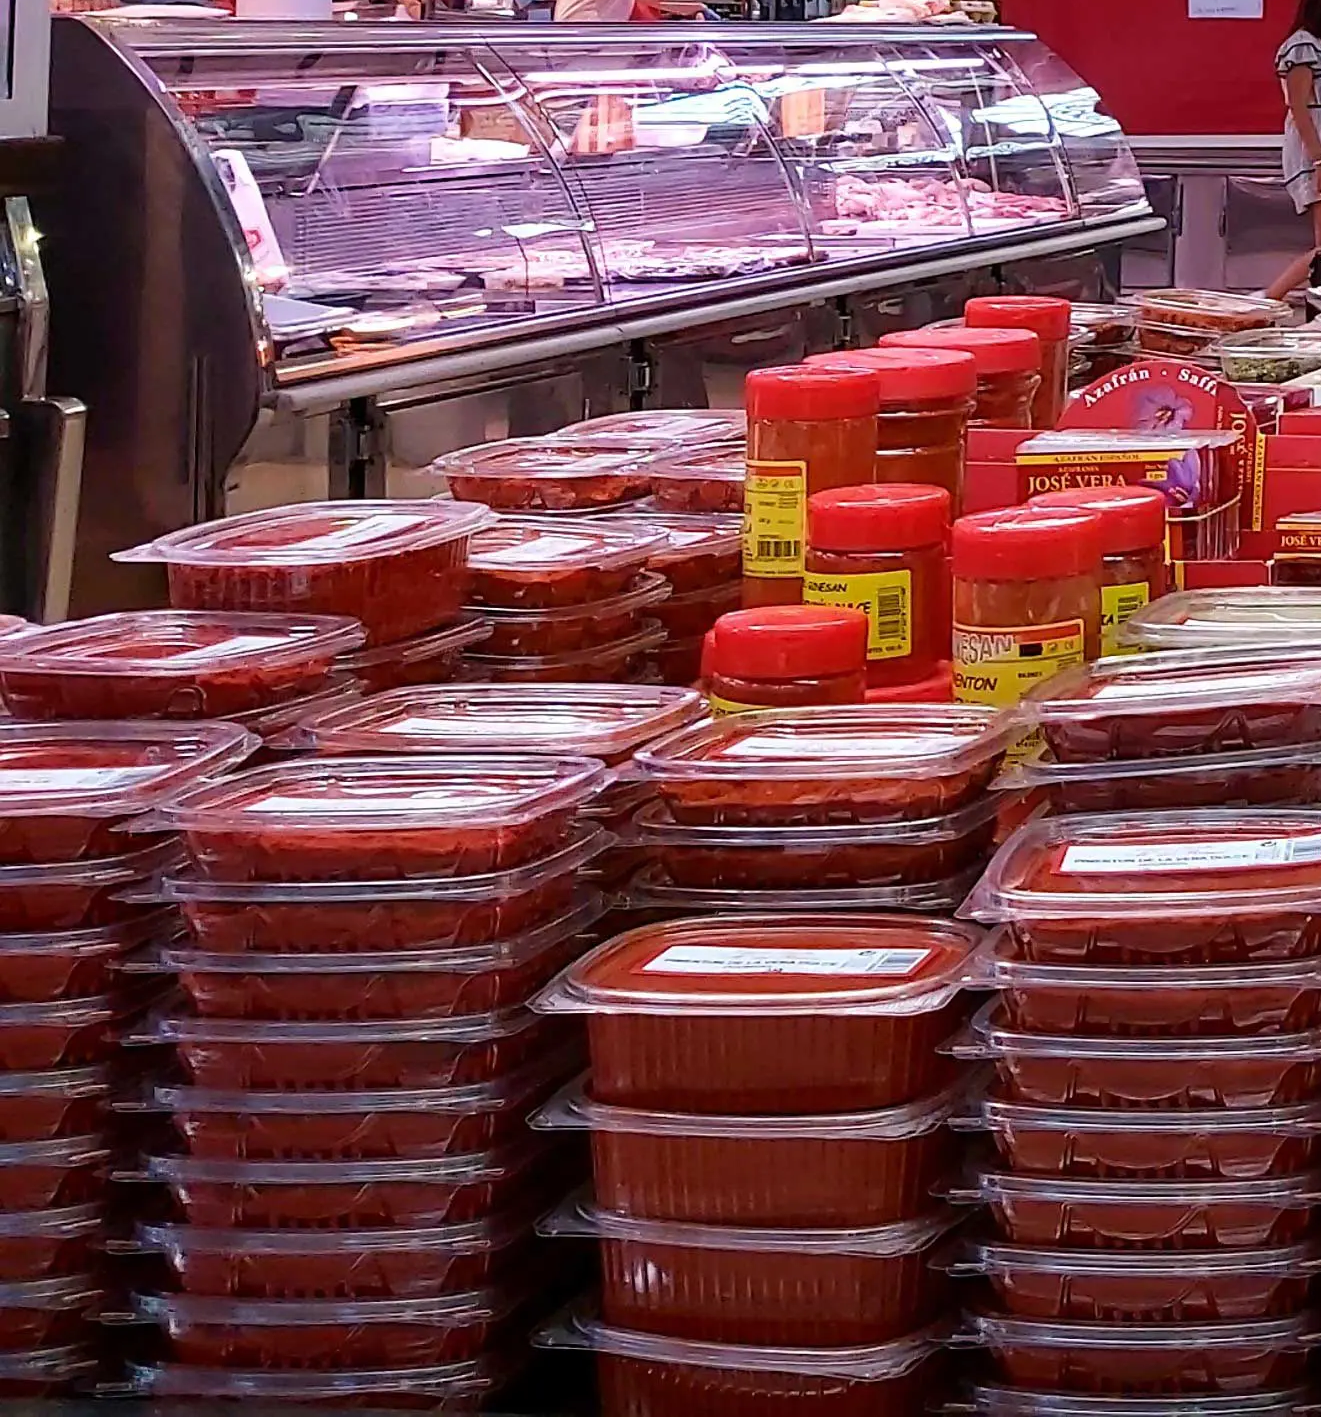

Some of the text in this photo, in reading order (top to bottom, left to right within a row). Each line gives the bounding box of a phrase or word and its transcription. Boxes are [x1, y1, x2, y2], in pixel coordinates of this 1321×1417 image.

[1084, 367, 1150, 408] Azafrán
[1027, 472, 1127, 495] JOSÉ VERA
[1281, 534, 1307, 547] JOSÉ
